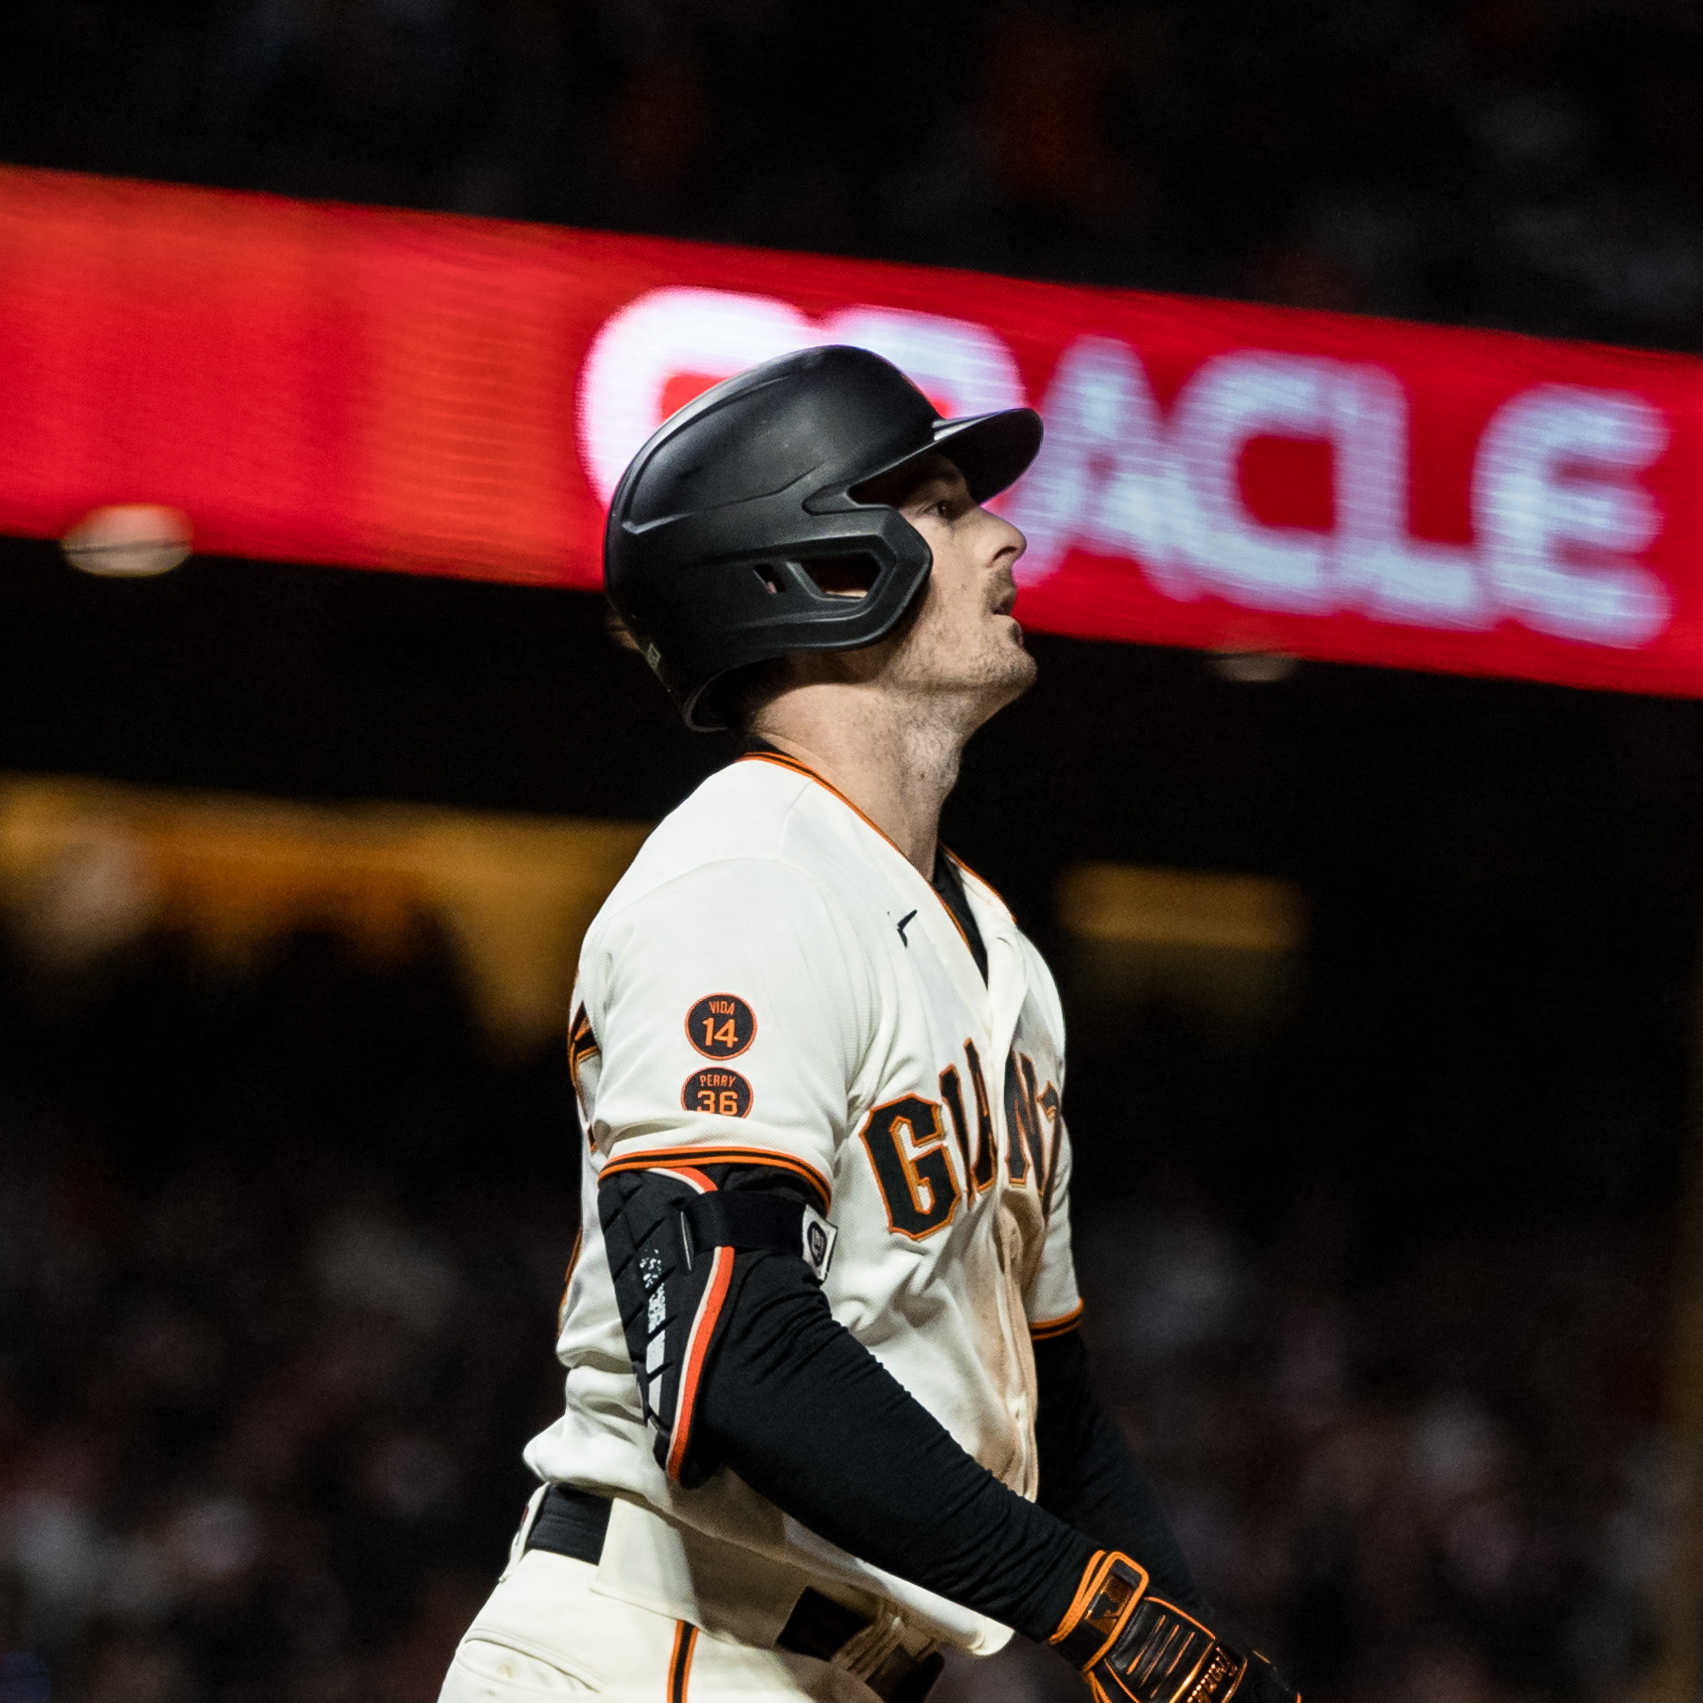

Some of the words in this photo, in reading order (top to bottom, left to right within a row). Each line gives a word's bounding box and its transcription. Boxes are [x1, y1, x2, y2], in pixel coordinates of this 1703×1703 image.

[709, 1001, 736, 1016] VIDA
[702, 1017, 739, 1048] 14
[699, 1074, 737, 1088] PERRY
[697, 1090, 739, 1116] 36
